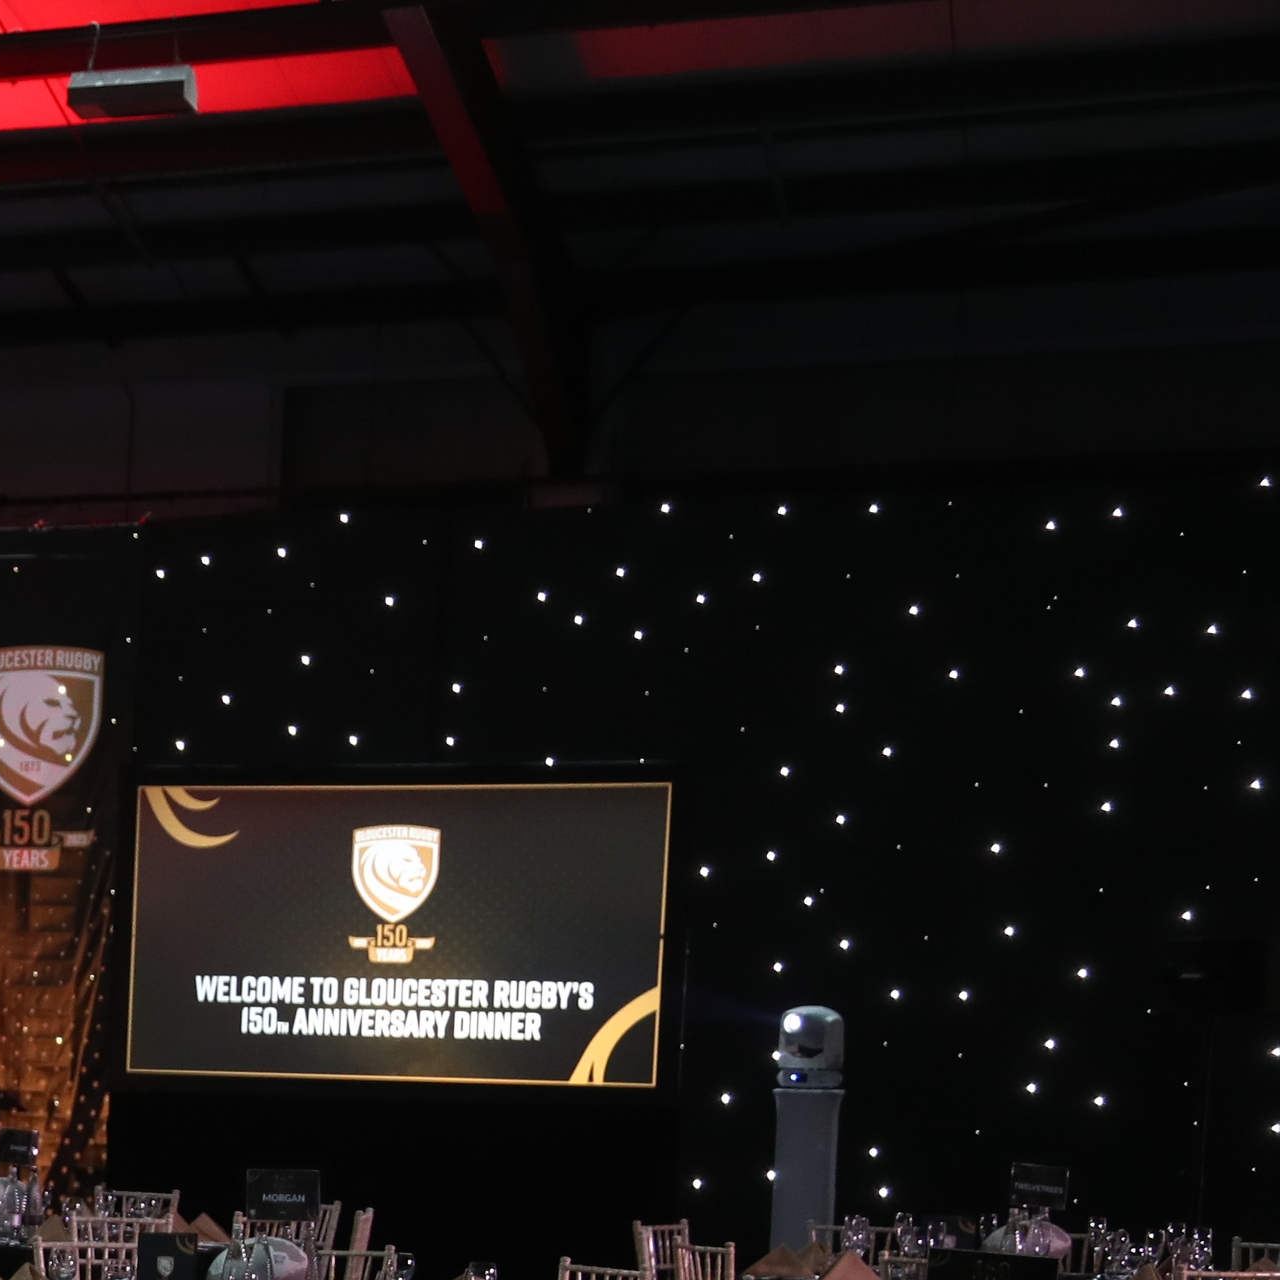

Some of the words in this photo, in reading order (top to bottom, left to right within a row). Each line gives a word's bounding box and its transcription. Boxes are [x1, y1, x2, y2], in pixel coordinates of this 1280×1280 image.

[56, 650, 101, 672] RUGBY
[3, 809, 51, 845] 150
[3, 849, 50, 868] YEARS
[376, 924, 408, 947] 150
[376, 948, 407, 962] YEARS
[195, 975, 306, 1005] WELCOME
[310, 977, 338, 1005] TO
[343, 977, 488, 1008] GLOUCESTER
[493, 980, 595, 1011] RUGBY'S
[292, 1008, 450, 1040] ANNIVERSARY
[454, 1011, 542, 1042] DINNER
[262, 1193, 305, 1202] MORGAN
